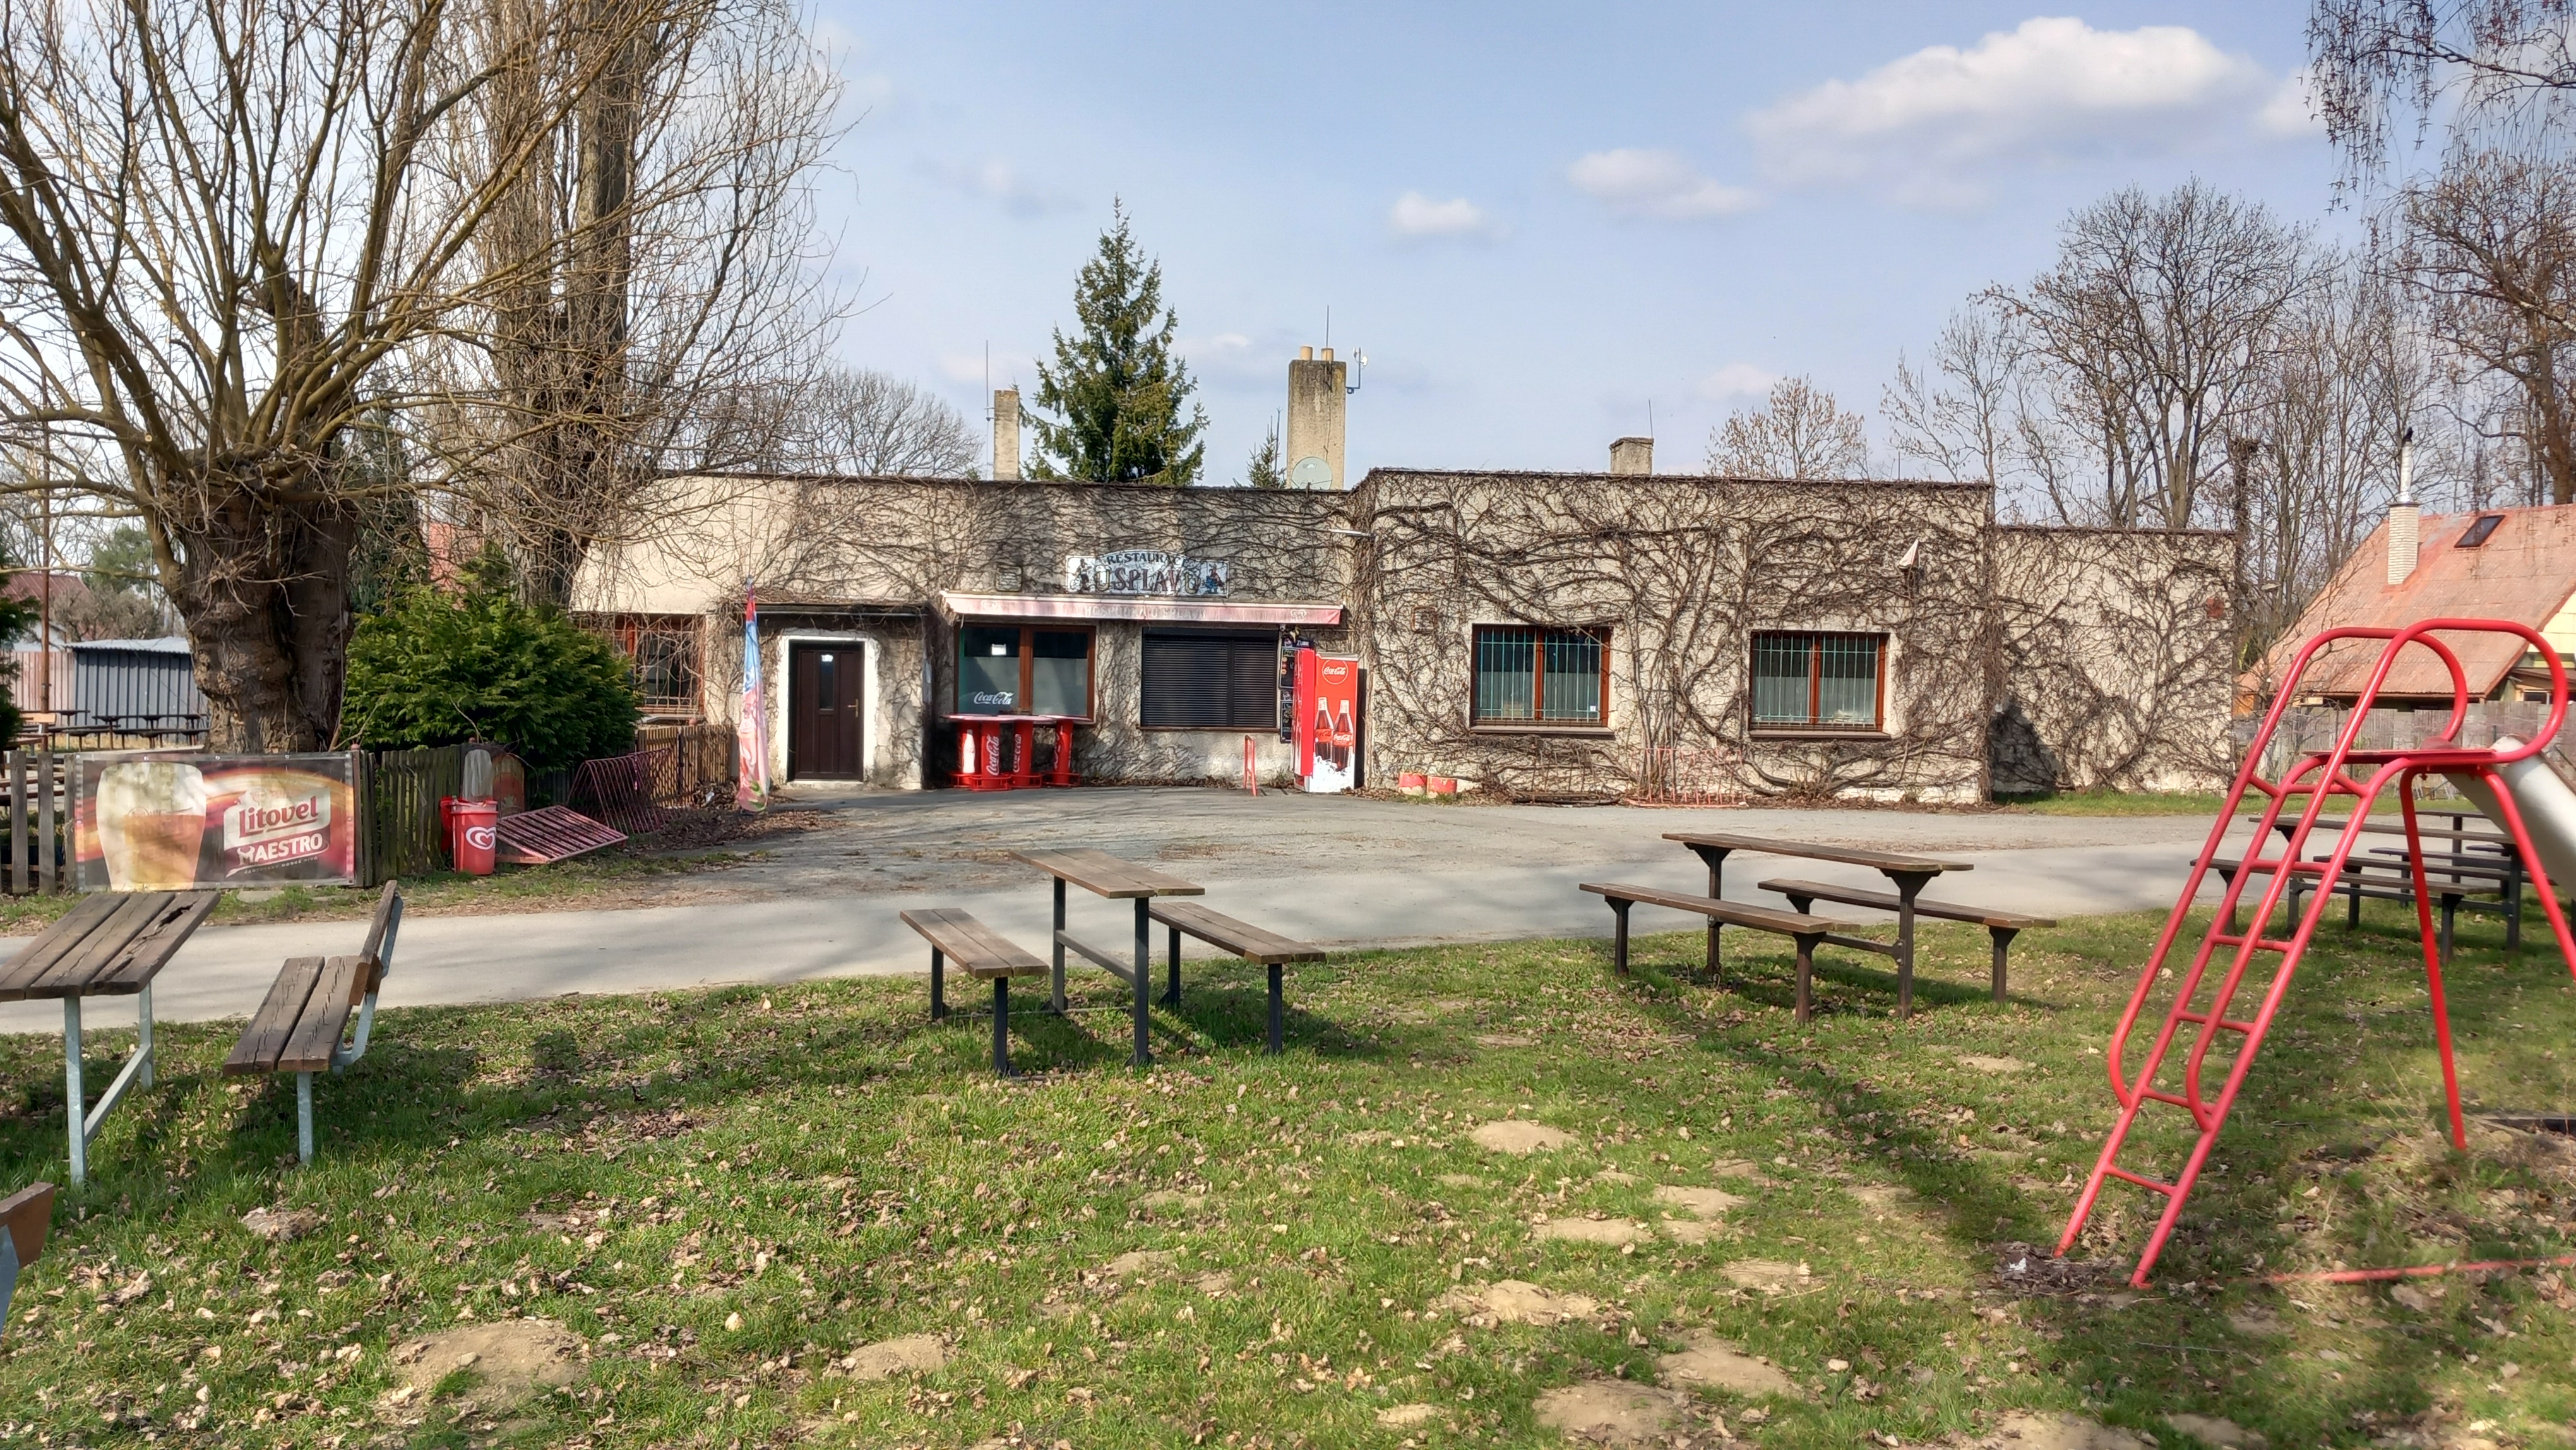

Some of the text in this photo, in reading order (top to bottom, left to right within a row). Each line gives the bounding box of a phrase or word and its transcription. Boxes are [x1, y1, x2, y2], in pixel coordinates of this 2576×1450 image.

[1106, 553, 1188, 567] RESTAURACE
[239, 796, 318, 839] Litovel
[237, 833, 323, 866] MAESTRO
